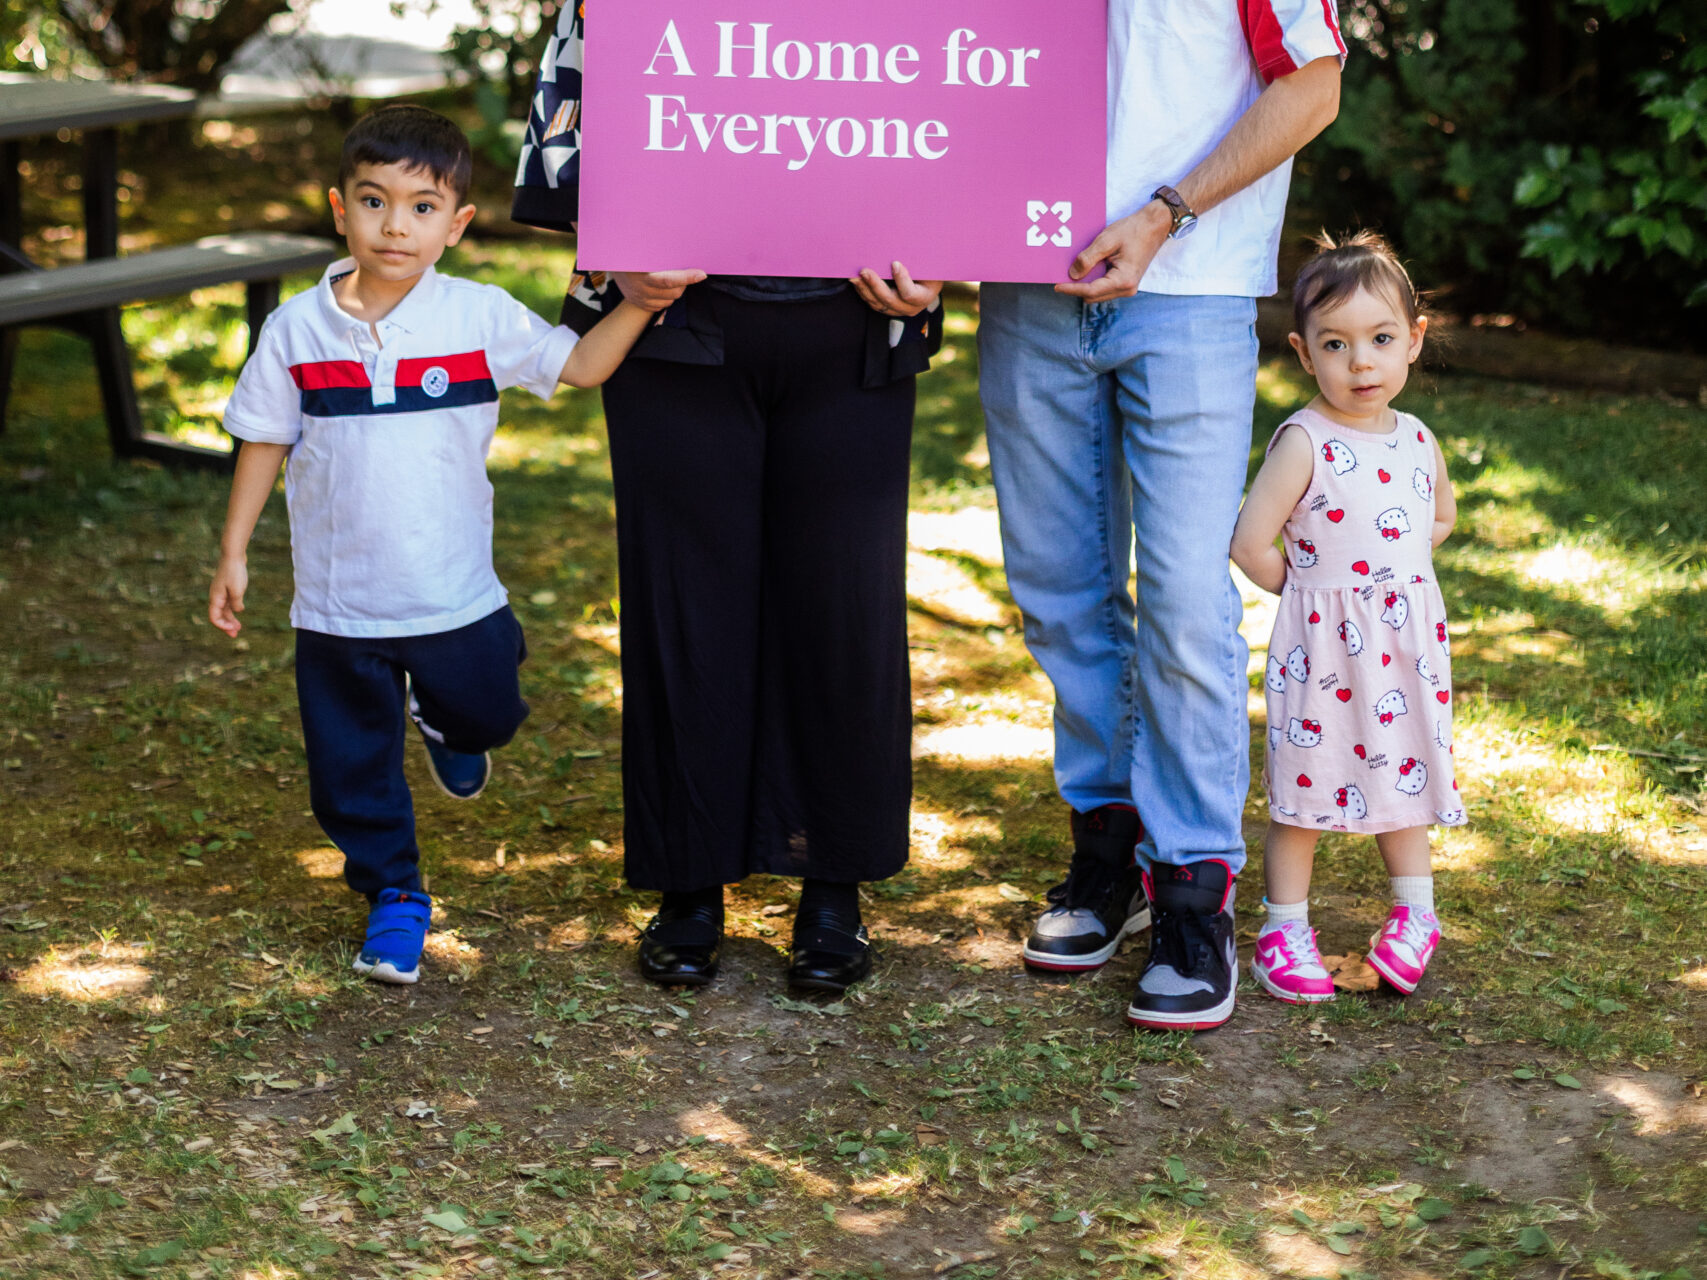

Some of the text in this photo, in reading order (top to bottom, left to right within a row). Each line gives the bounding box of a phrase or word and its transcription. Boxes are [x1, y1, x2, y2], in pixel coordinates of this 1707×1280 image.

[643, 18, 1041, 88] A Home for
[643, 93, 949, 171] Everyone
